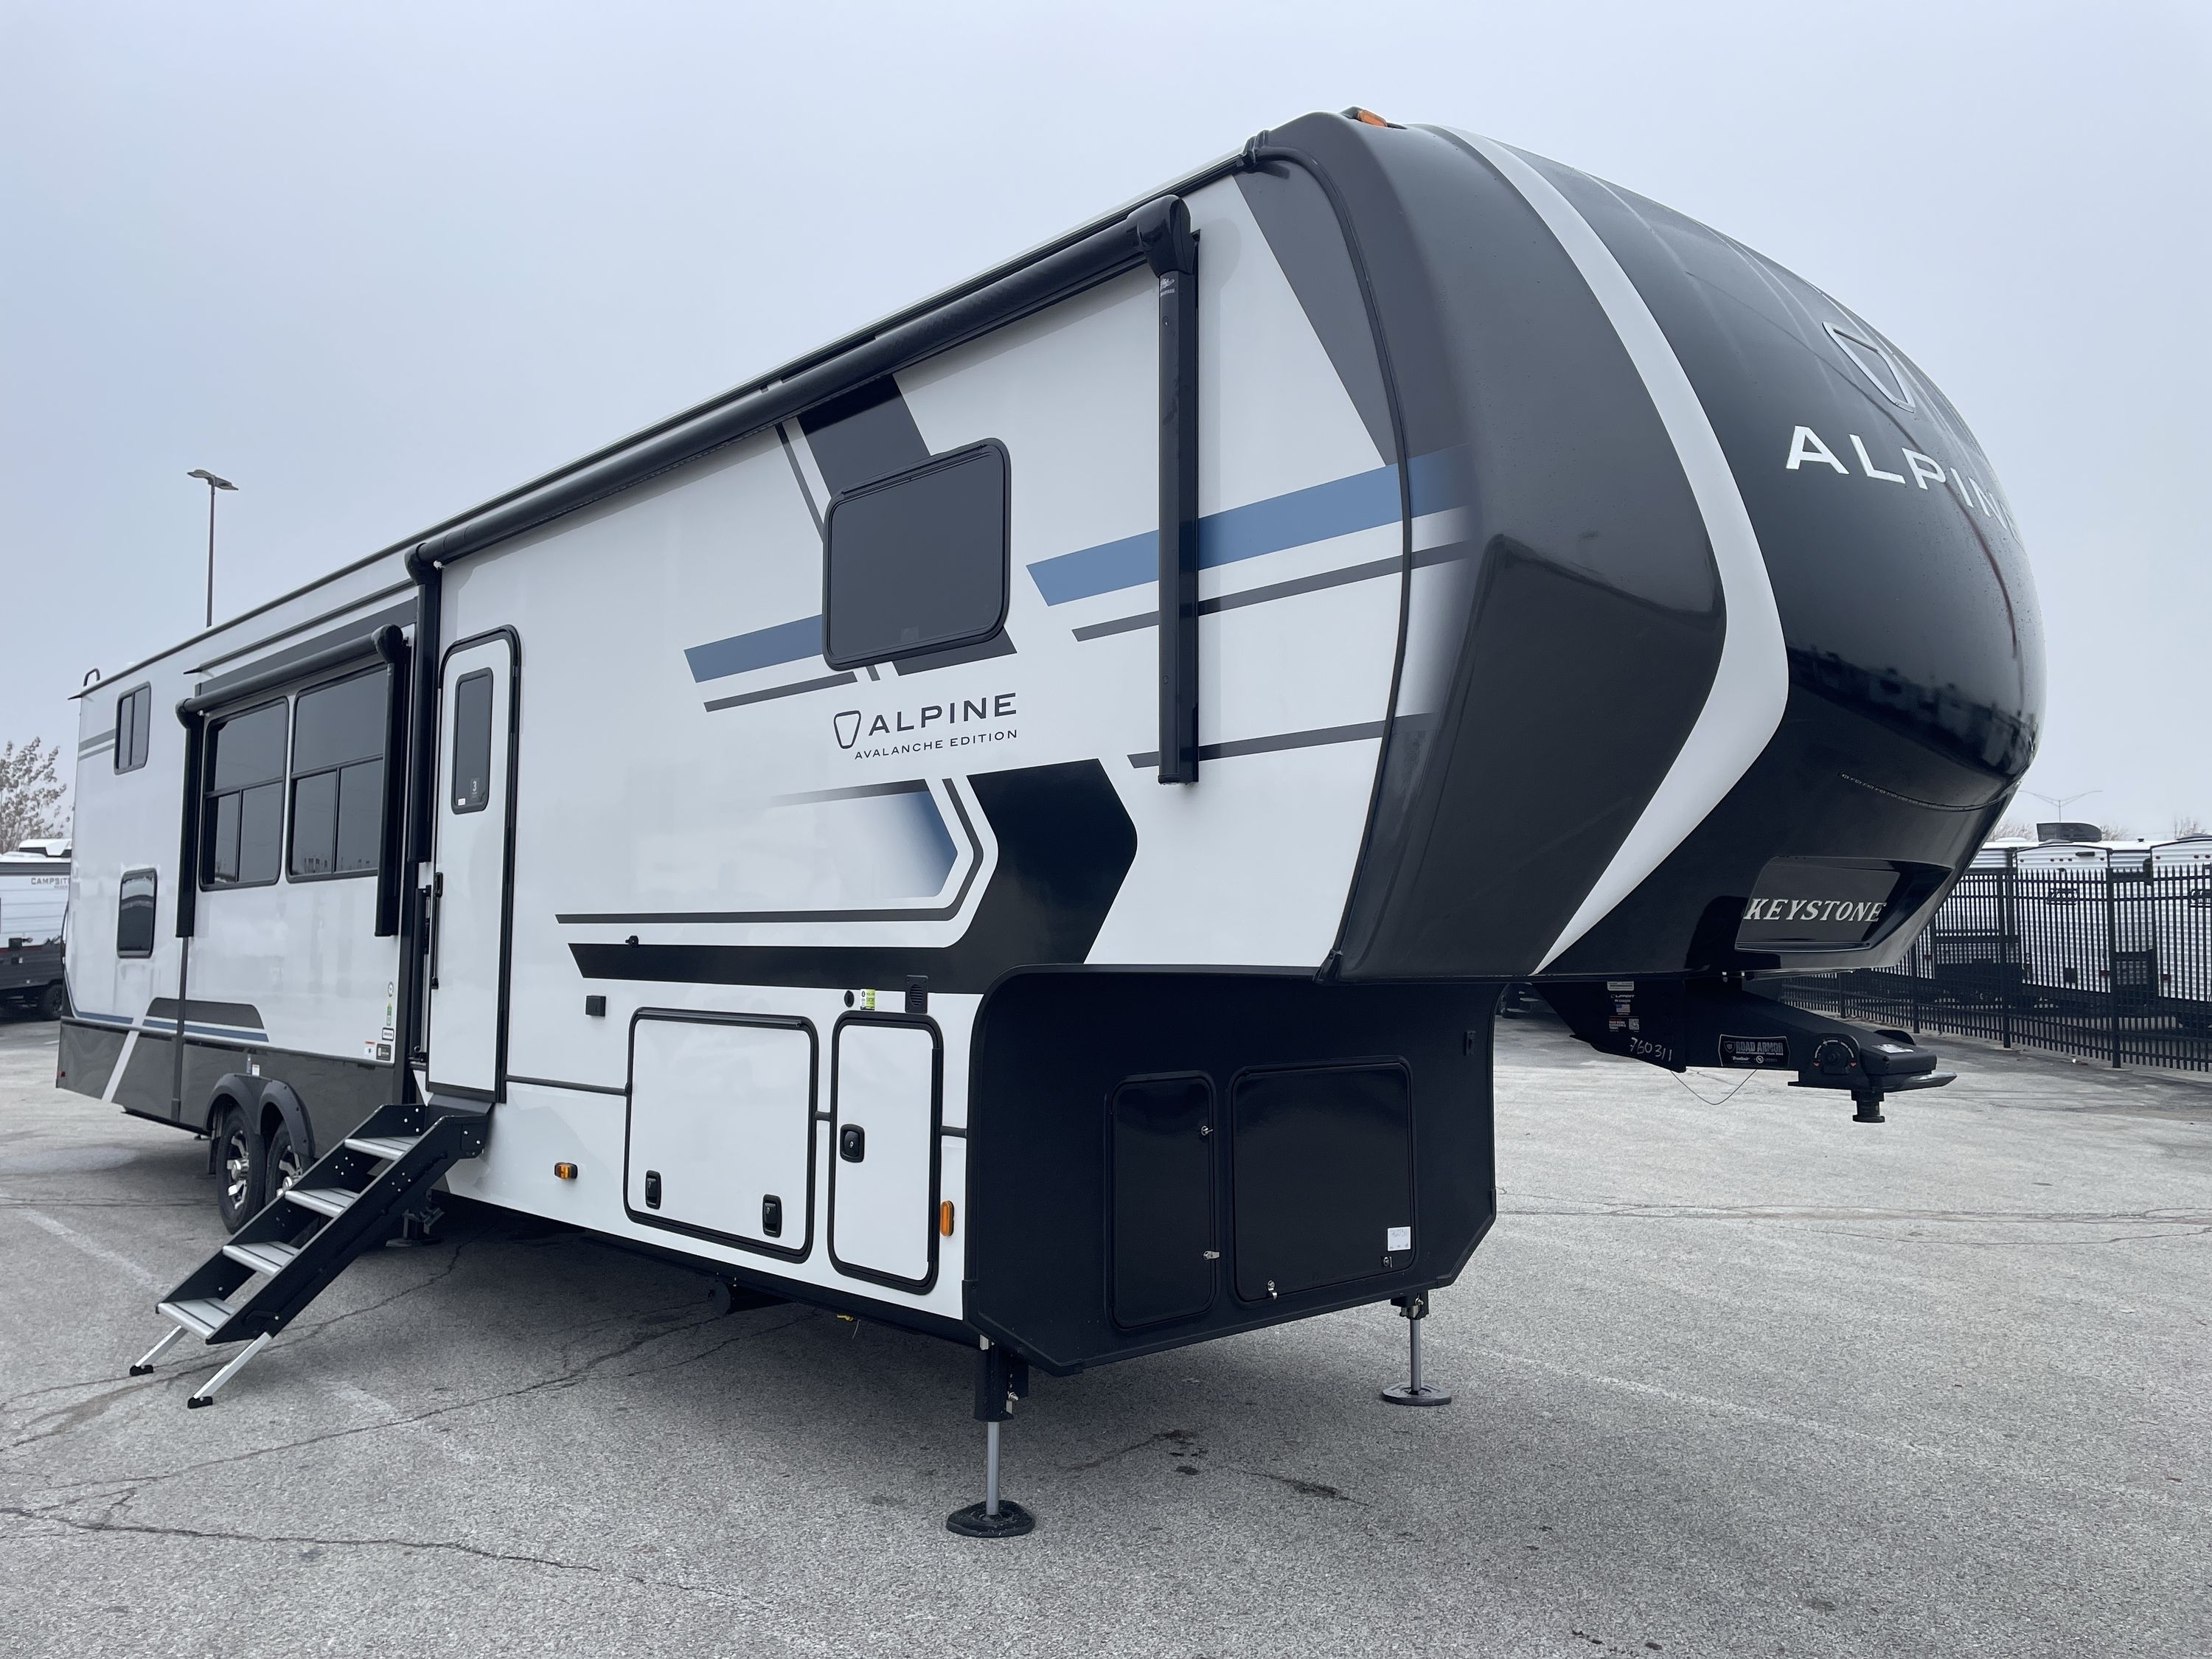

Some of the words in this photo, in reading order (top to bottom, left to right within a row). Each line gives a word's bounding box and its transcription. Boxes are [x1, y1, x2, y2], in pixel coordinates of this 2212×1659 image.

[869, 692, 1017, 737] ALPINE
[855, 740, 944, 760] AVALANCHE
[950, 729, 1018, 748] EDITION
[1743, 898, 1887, 922] KEYSTONE
[1630, 1037, 1672, 1062] 760311
[1736, 1041, 1756, 1052] ROAD
[1757, 1041, 1784, 1054] ARMOR
